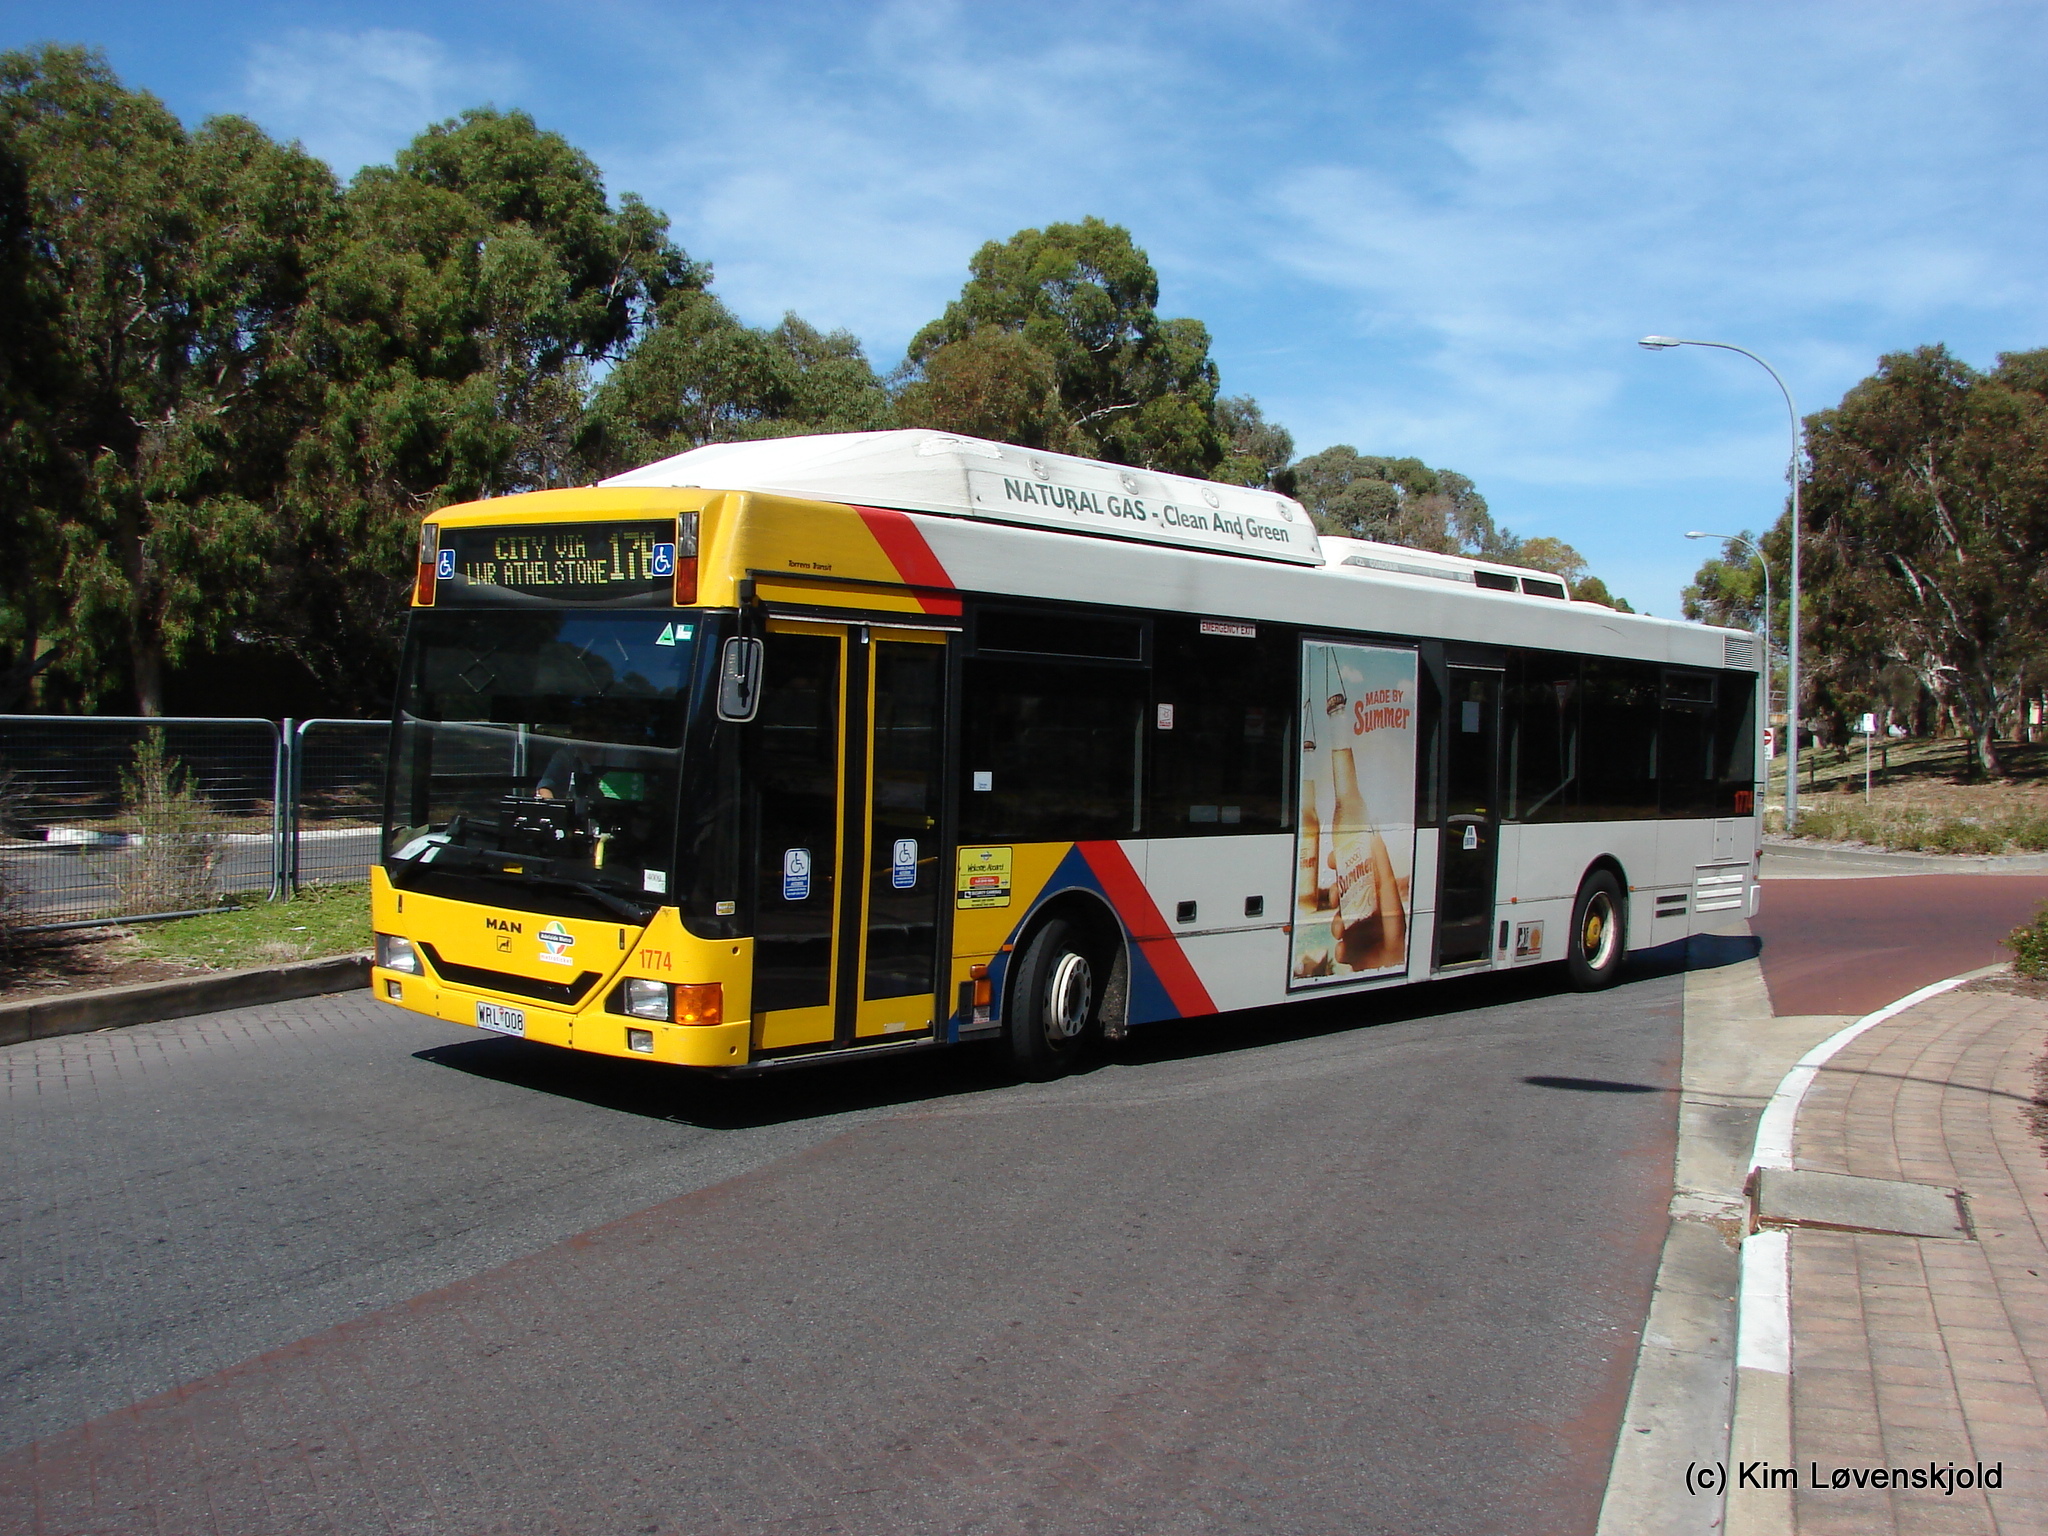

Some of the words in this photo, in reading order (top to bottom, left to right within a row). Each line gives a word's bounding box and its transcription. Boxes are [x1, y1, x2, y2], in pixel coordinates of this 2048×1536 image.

[1003, 477, 1104, 515] NATURAL
[1107, 496, 1147, 522] GAS
[1162, 504, 1208, 531] Clean
[1212, 512, 1244, 537] And
[1245, 517, 1290, 543] Green
[494, 535, 547, 560] CITY
[554, 534, 586, 558] VIA
[466, 561, 497, 585] LWR
[503, 558, 609, 584] ATHELSTONE
[1202, 621, 1239, 634] EMERGENCY
[1240, 625, 1255, 636] EXIT
[1365, 689, 1391, 706] MADE
[1392, 689, 1404, 703] BY
[1353, 700, 1411, 736] Summer
[486, 917, 522, 934] MAN
[639, 948, 672, 972] 1774
[478, 1004, 500, 1026] WRL
[504, 1010, 524, 1031] 008
